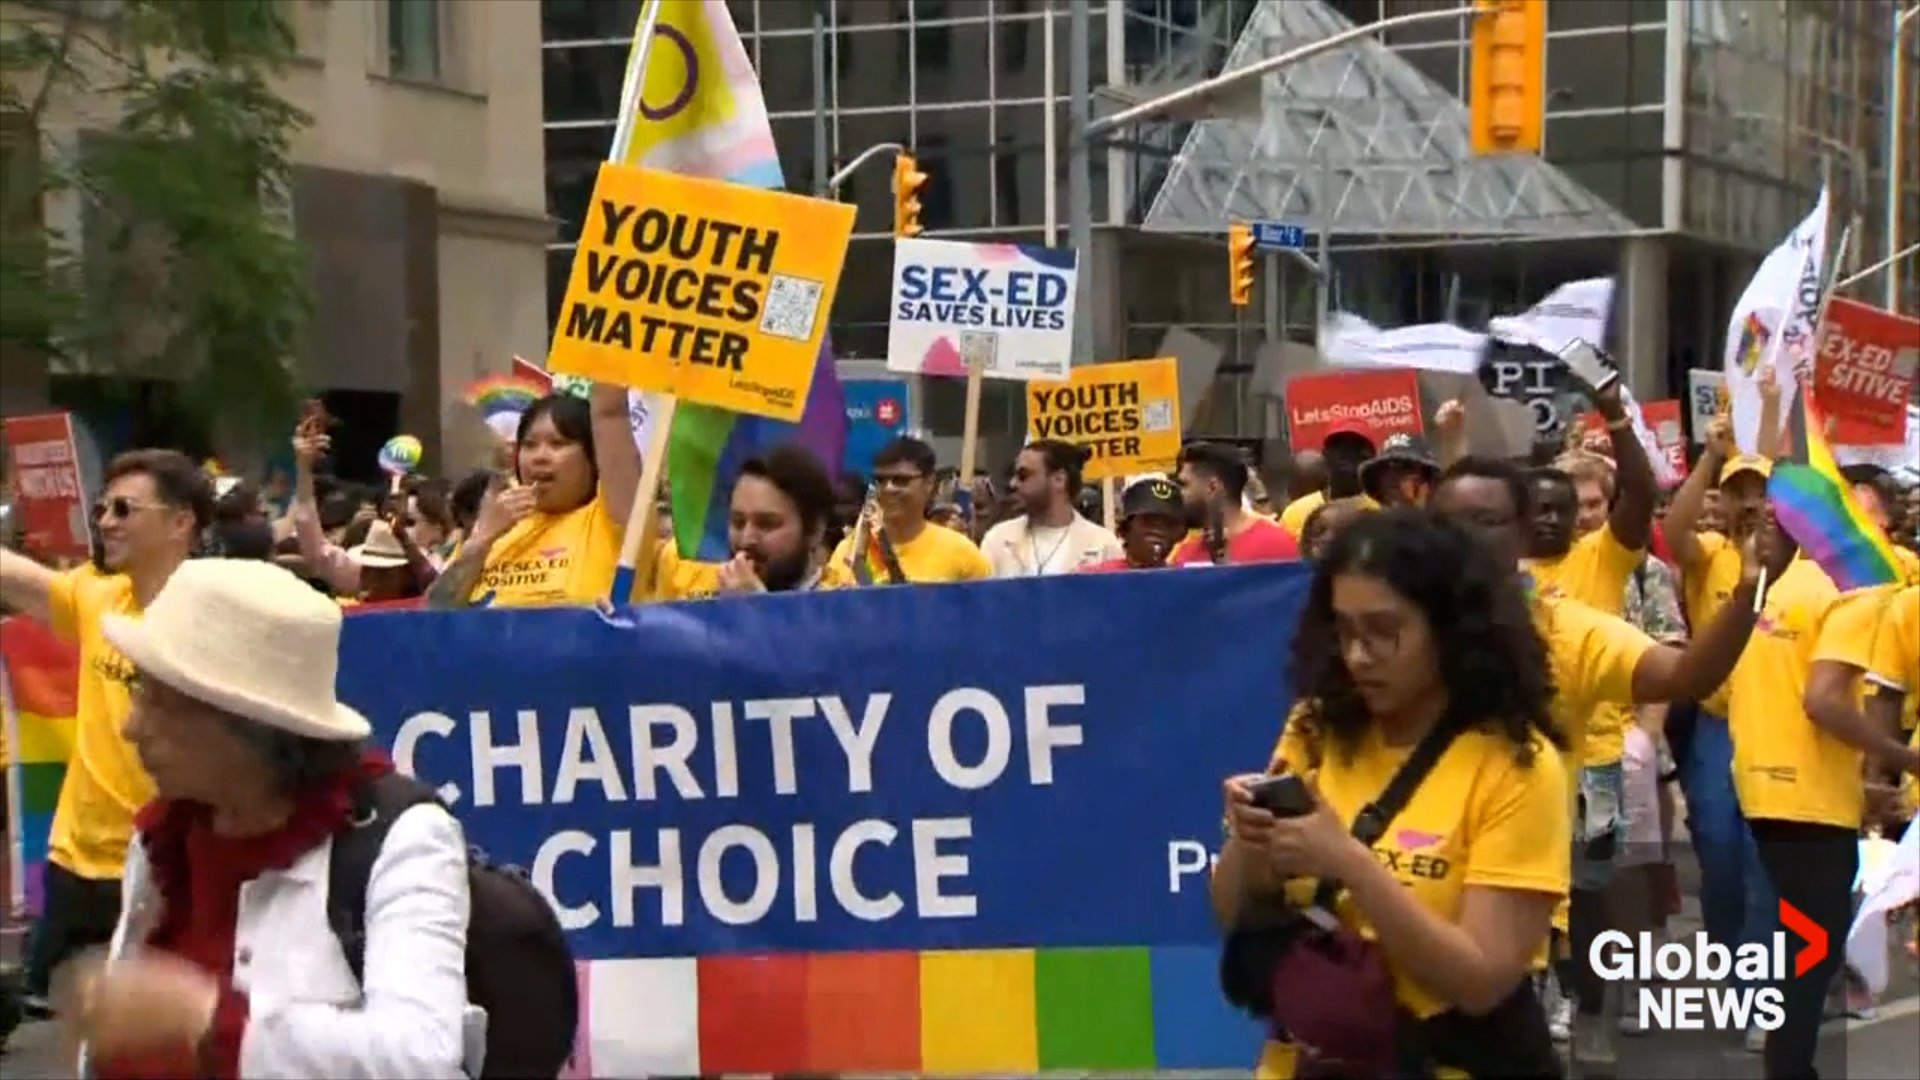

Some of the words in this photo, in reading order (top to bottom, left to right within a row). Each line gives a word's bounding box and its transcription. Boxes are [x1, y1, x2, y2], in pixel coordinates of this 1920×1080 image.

[602, 200, 779, 274] YOUTH
[587, 251, 762, 322] VOICES
[901, 265, 1068, 308] SEX-ED
[565, 303, 749, 371] MATTER
[898, 302, 984, 325] SAVES
[991, 306, 1064, 330] LIVES
[1033, 381, 1139, 413] YOUTH
[1827, 363, 1910, 403] SITIVE
[1035, 408, 1140, 437] VOICES
[391, 693, 892, 807] CHARITY
[927, 684, 1086, 790] OF
[532, 817, 977, 931] CHOICE
